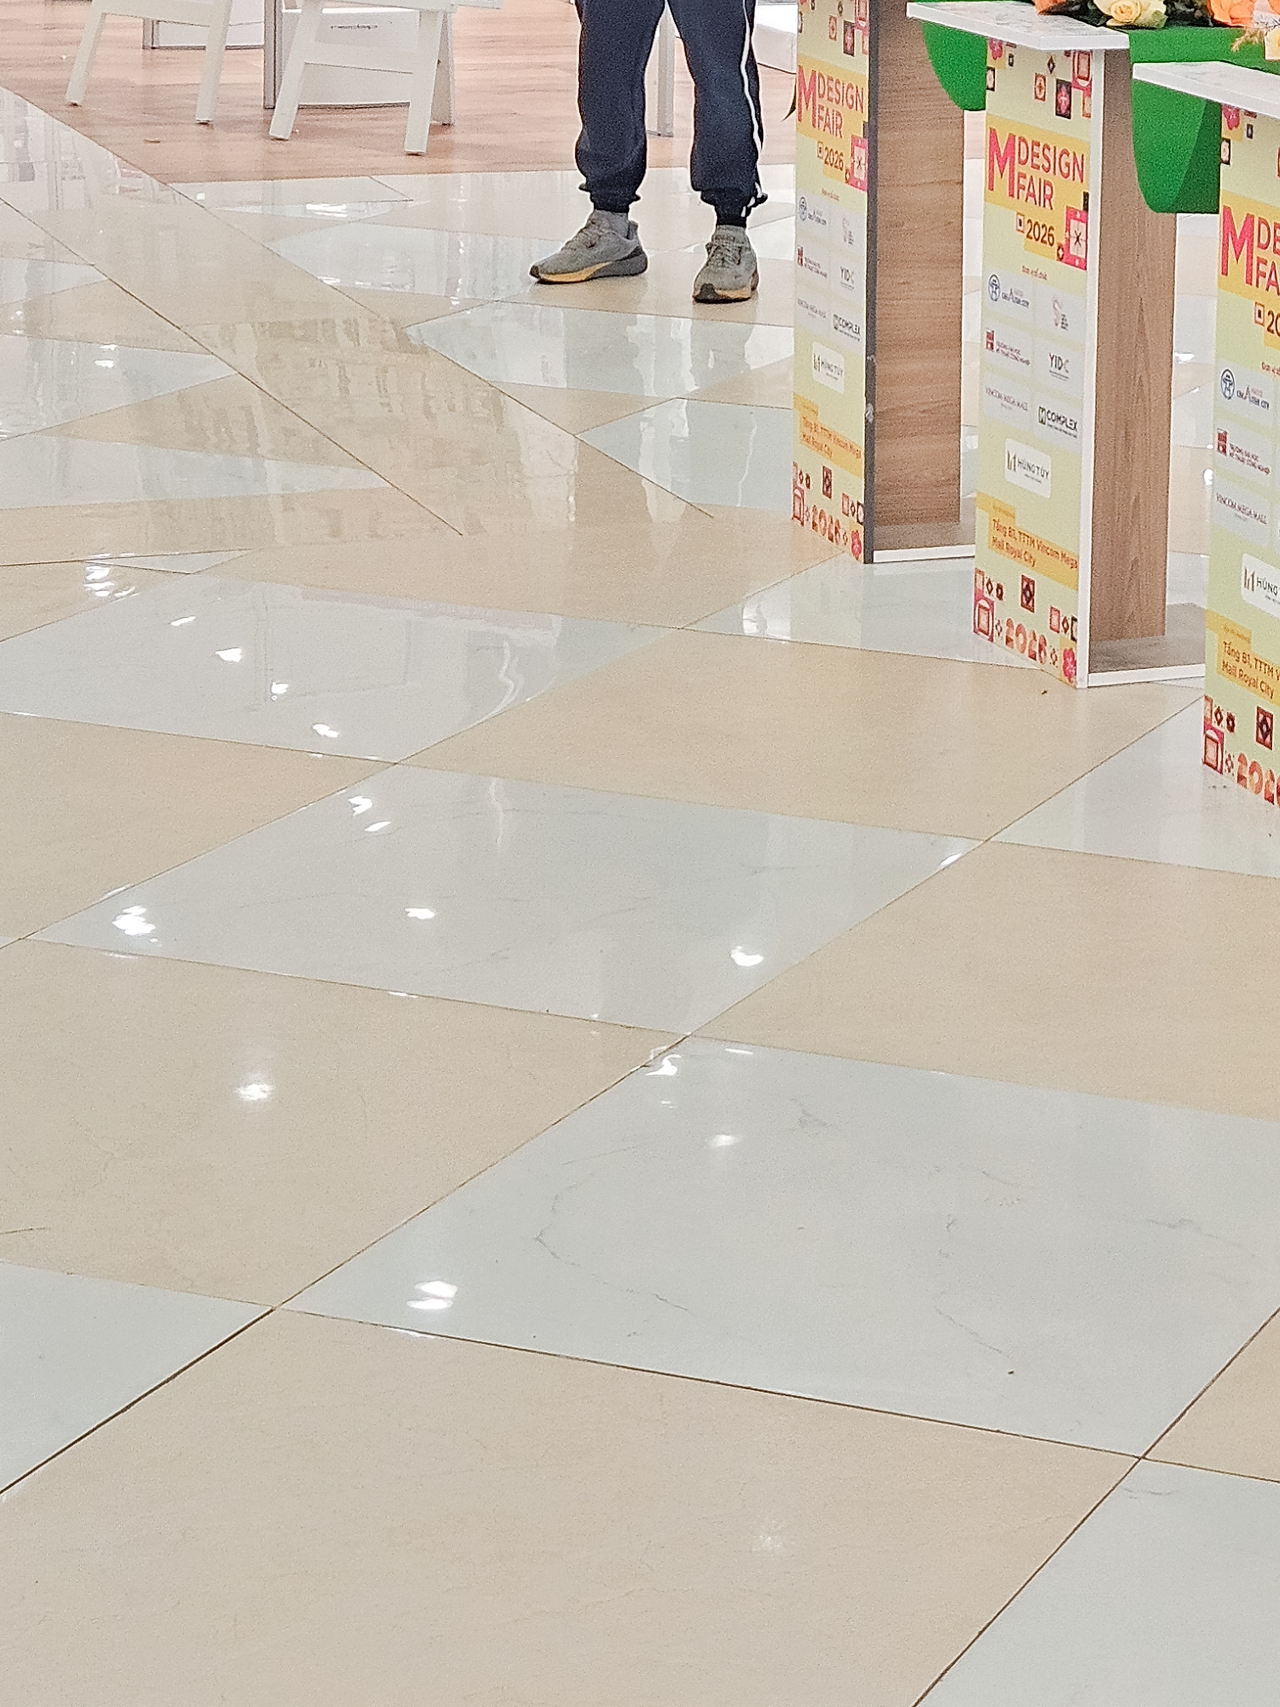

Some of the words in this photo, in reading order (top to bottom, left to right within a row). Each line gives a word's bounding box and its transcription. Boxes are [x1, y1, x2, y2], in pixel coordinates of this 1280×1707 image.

[797, 65, 816, 129] M
[817, 69, 864, 114] DESIGN
[816, 103, 843, 139] FAIR
[823, 145, 844, 173] 2026
[987, 126, 1016, 198] M
[1017, 136, 1085, 184] DESIGN
[1016, 179, 1054, 211] FAIR
[1026, 219, 1055, 247] 2026
[1221, 205, 1254, 286] M
[1048, 353, 1070, 374] YIDC
[1005, 617, 1048, 665] 2026
